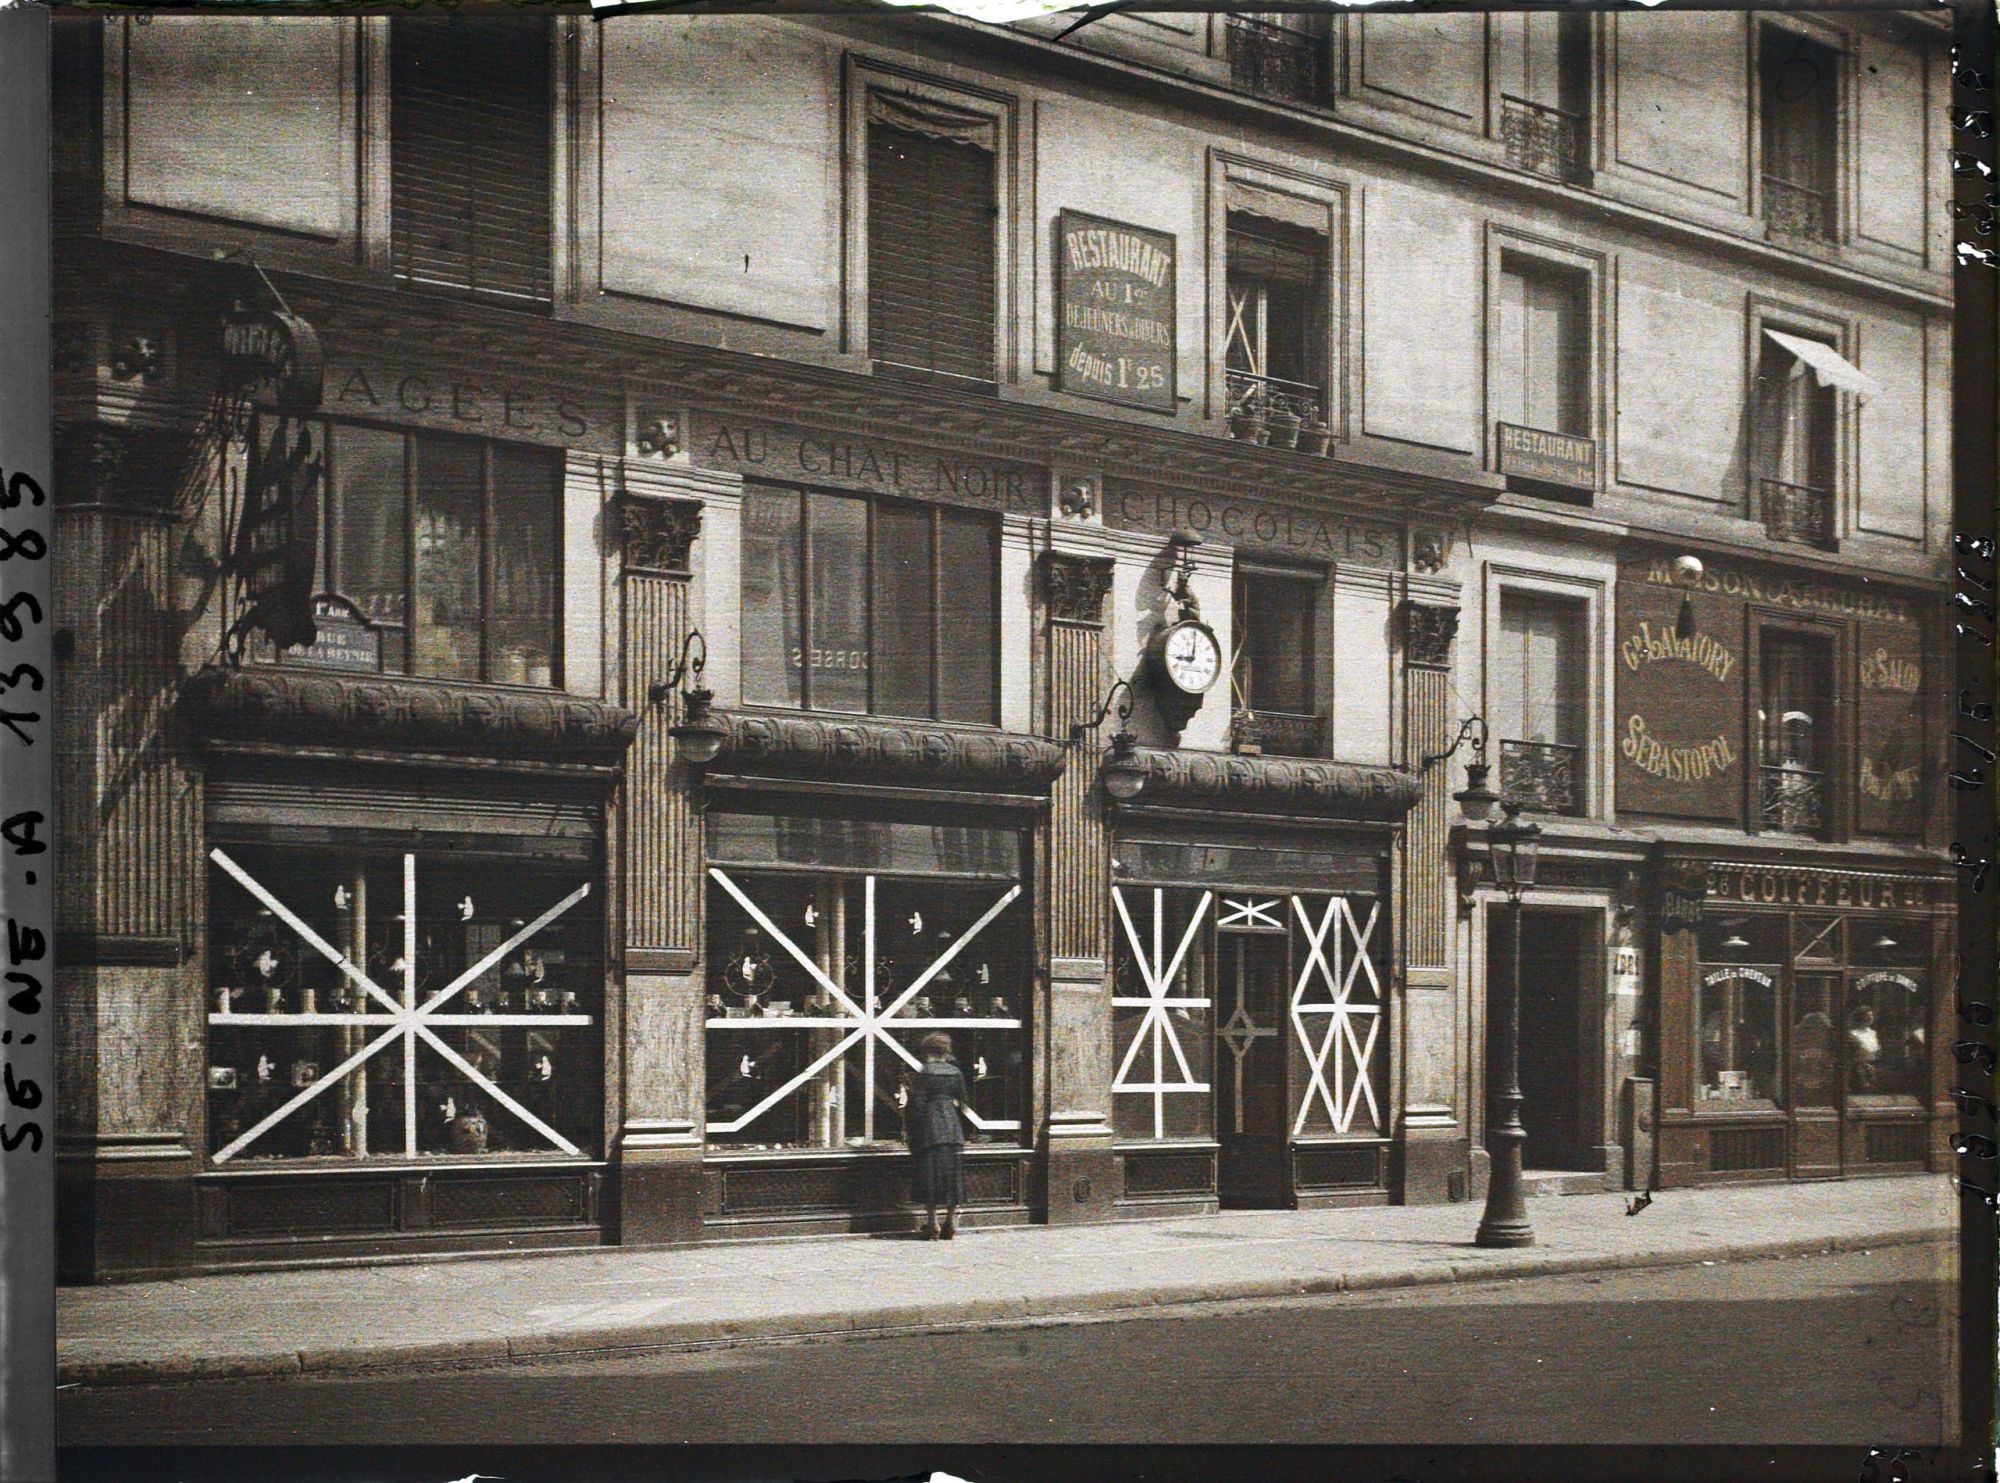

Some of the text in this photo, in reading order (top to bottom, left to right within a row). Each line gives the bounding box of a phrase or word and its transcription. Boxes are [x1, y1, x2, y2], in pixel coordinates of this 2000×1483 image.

[1066, 229, 1172, 288] RESTAURANT
[1091, 279, 1117, 300] AU
[1069, 341, 1113, 385] depuis
[711, 425, 1026, 505] AU CHAT NOIR
[1504, 427, 1593, 466] RESTAURANT
[1120, 491, 1384, 560] CHOCOLATS
[1647, 559, 1762, 600] MSON
[1622, 714, 1737, 781] SEBASTOPOL
[1705, 873, 1730, 896] 26
[1740, 872, 1897, 908] COIFFEUR
